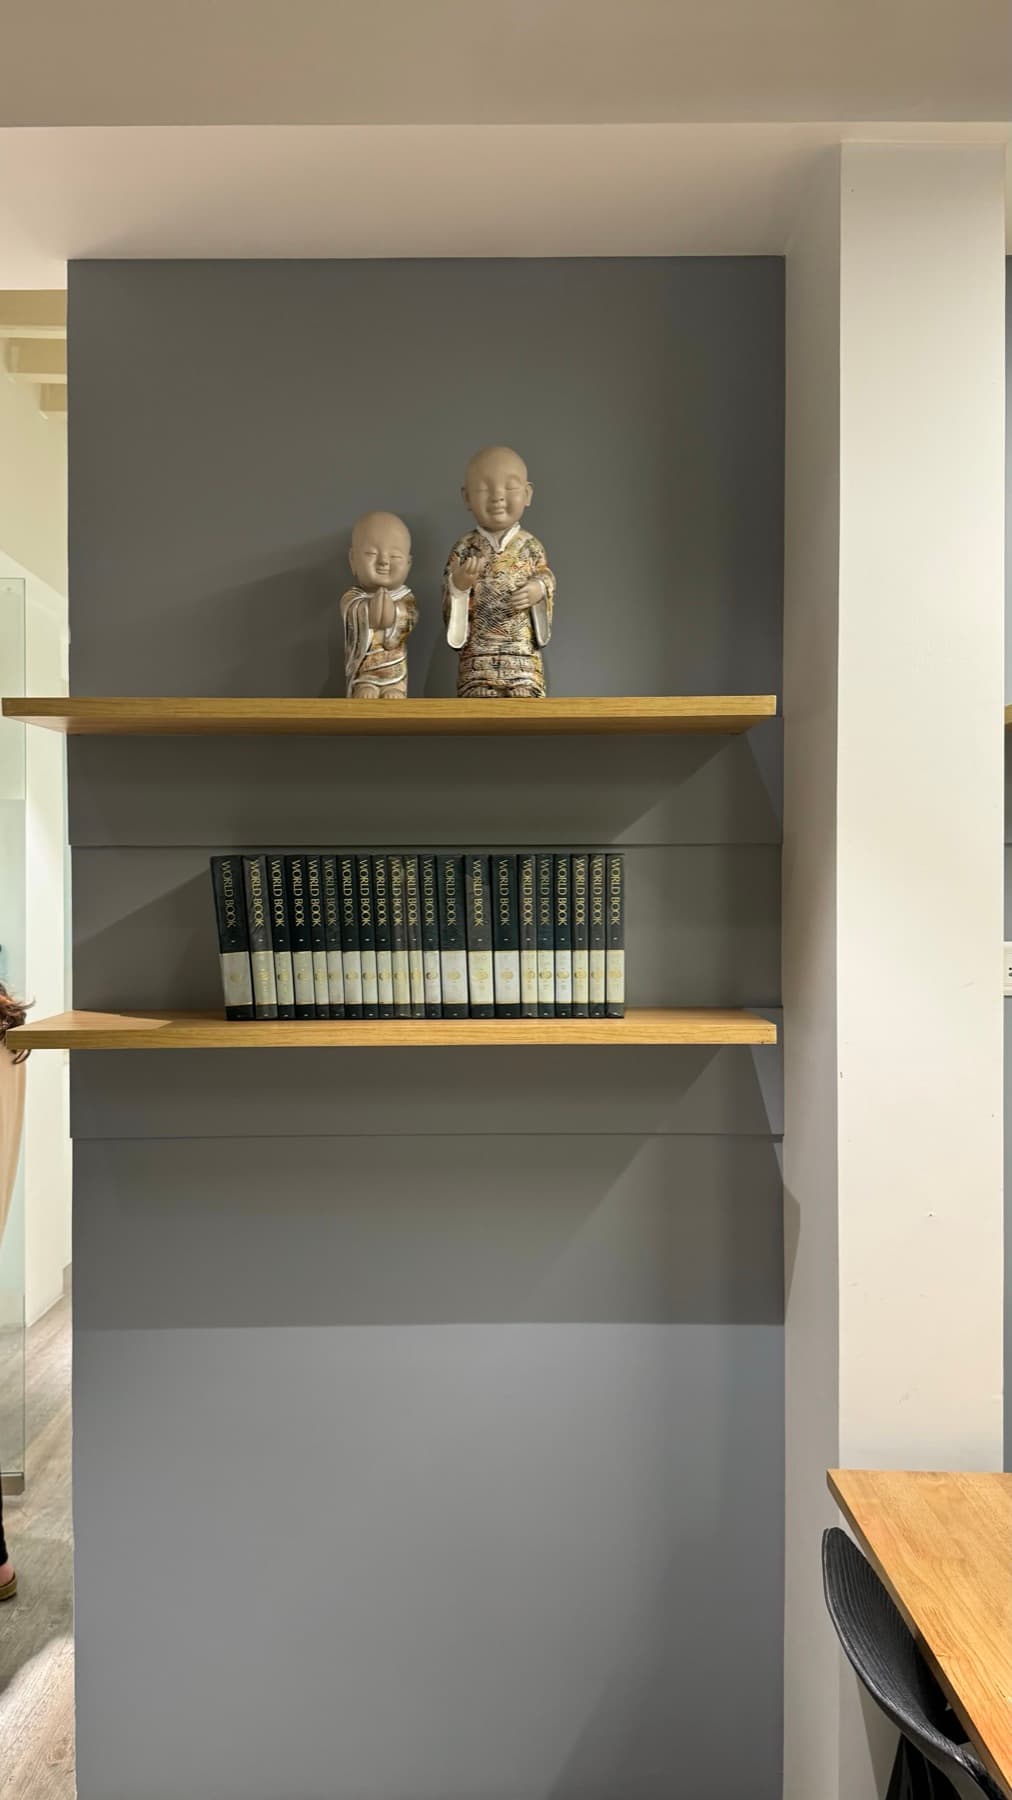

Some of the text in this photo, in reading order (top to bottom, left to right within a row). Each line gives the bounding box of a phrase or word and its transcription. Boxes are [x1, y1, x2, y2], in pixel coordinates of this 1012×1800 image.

[221, 860, 236, 928] WORLD BOOK
[250, 860, 265, 927] WORLD BOOK
[271, 860, 285, 927] WORLD BOOK
[292, 860, 305, 927] WORLD BOOK
[308, 860, 321, 927] WORLD BOOK
[324, 860, 337, 927] WORLD BOOK
[342, 859, 354, 927] WORLD BOOK
[359, 859, 371, 927] WORLD BOOK
[375, 859, 387, 927] WORLD BOOK
[391, 859, 403, 927] WORLD BOOK
[406, 859, 418, 926] WORLD BOOK
[423, 859, 435, 926] WORLD BOOK
[445, 859, 457, 926] WORLD BOOK
[473, 860, 484, 927] WORLD BOOK
[499, 859, 511, 926] WORLD BOOK
[523, 859, 533, 926] WORLD BOOK
[541, 859, 551, 926] WORLD BOOK
[558, 859, 568, 926] WORLD BOOK
[576, 859, 585, 926] WORLD BOOK
[592, 858, 602, 926] WORLD BOOK
[610, 858, 621, 925] WORLD BOOK
